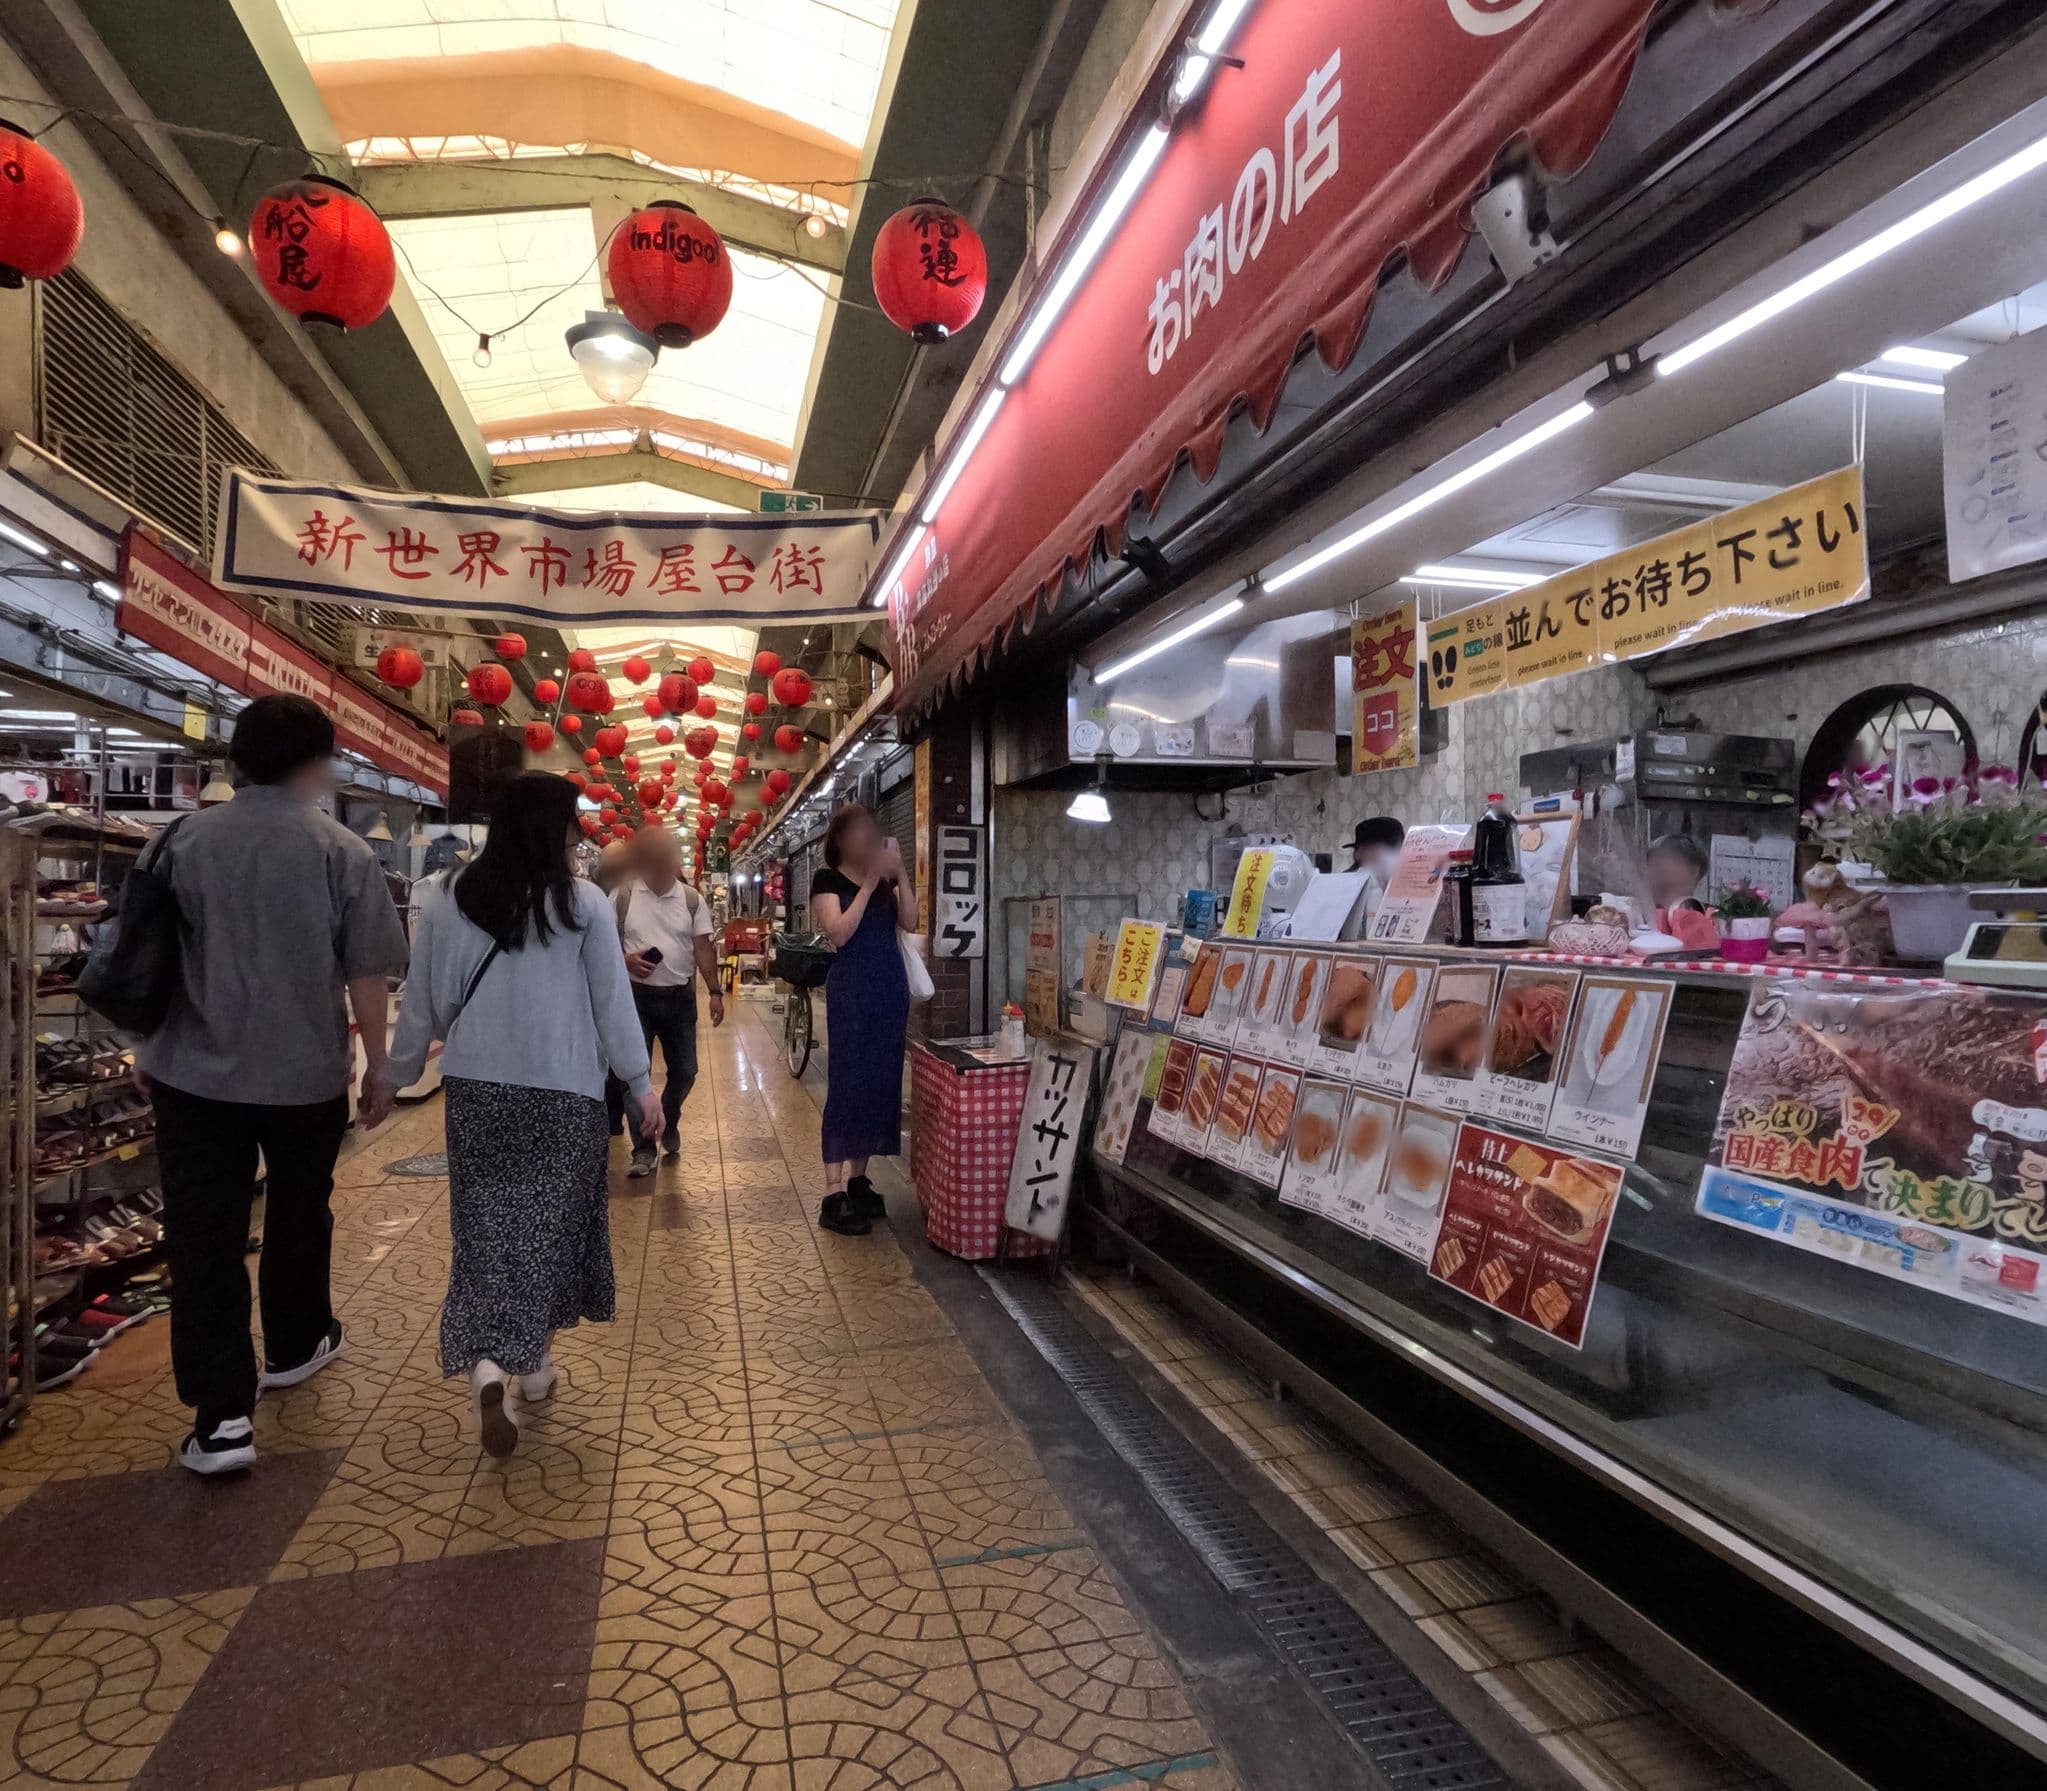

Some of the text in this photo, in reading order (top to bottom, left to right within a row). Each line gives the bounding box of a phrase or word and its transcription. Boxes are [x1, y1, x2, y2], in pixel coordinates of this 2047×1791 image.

[1147, 47, 1342, 376] お肉の店
[296, 509, 826, 599] 新世界市場屋台街
[1505, 501, 1860, 651] 並んでお待ち下さい
[1774, 591, 1801, 607] wait
[1803, 586, 1815, 601] in
[1466, 614, 1494, 634] 足もと
[1614, 632, 1643, 650] please
[1644, 626, 1666, 643] wait
[1353, 624, 1416, 694] 注文
[1517, 661, 1541, 677] please
[1541, 657, 1559, 671] wait
[1367, 709, 1395, 734] ココ
[941, 828, 980, 959] コロッケ
[1117, 929, 1137, 982] こちら
[1130, 929, 1157, 999] ご注文は
[1574, 1110, 1616, 1128] ウインナー
[1736, 1104, 1818, 1132] やっぱり
[1725, 1132, 1864, 1187] 国産食肉
